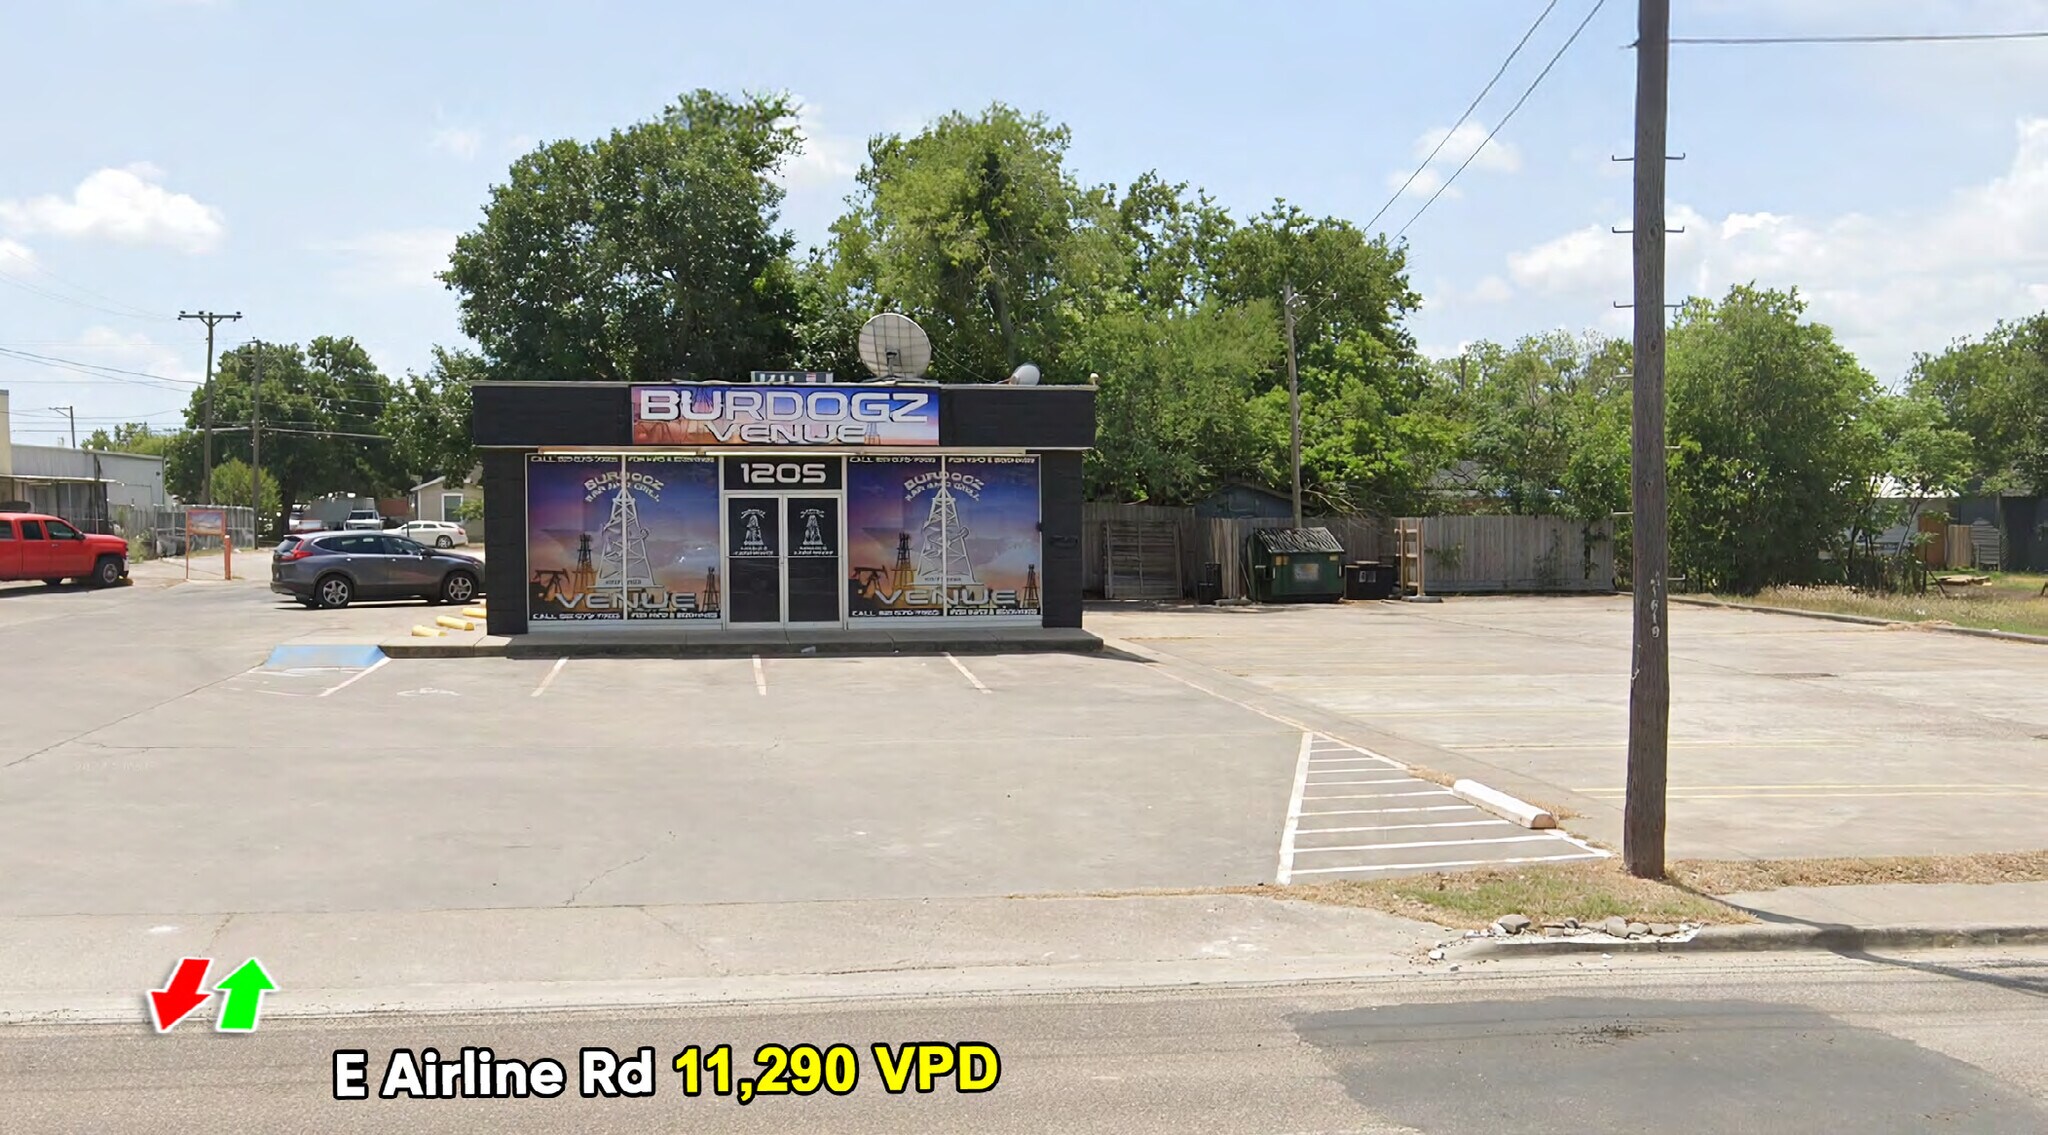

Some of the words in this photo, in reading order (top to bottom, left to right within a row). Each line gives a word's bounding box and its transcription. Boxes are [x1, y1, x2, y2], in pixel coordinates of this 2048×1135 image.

[640, 389, 929, 423] BURDOGZ
[704, 423, 867, 444] VENUE
[740, 463, 827, 484] 1205
[555, 591, 697, 610] VENUE
[875, 588, 1017, 606] VENUE
